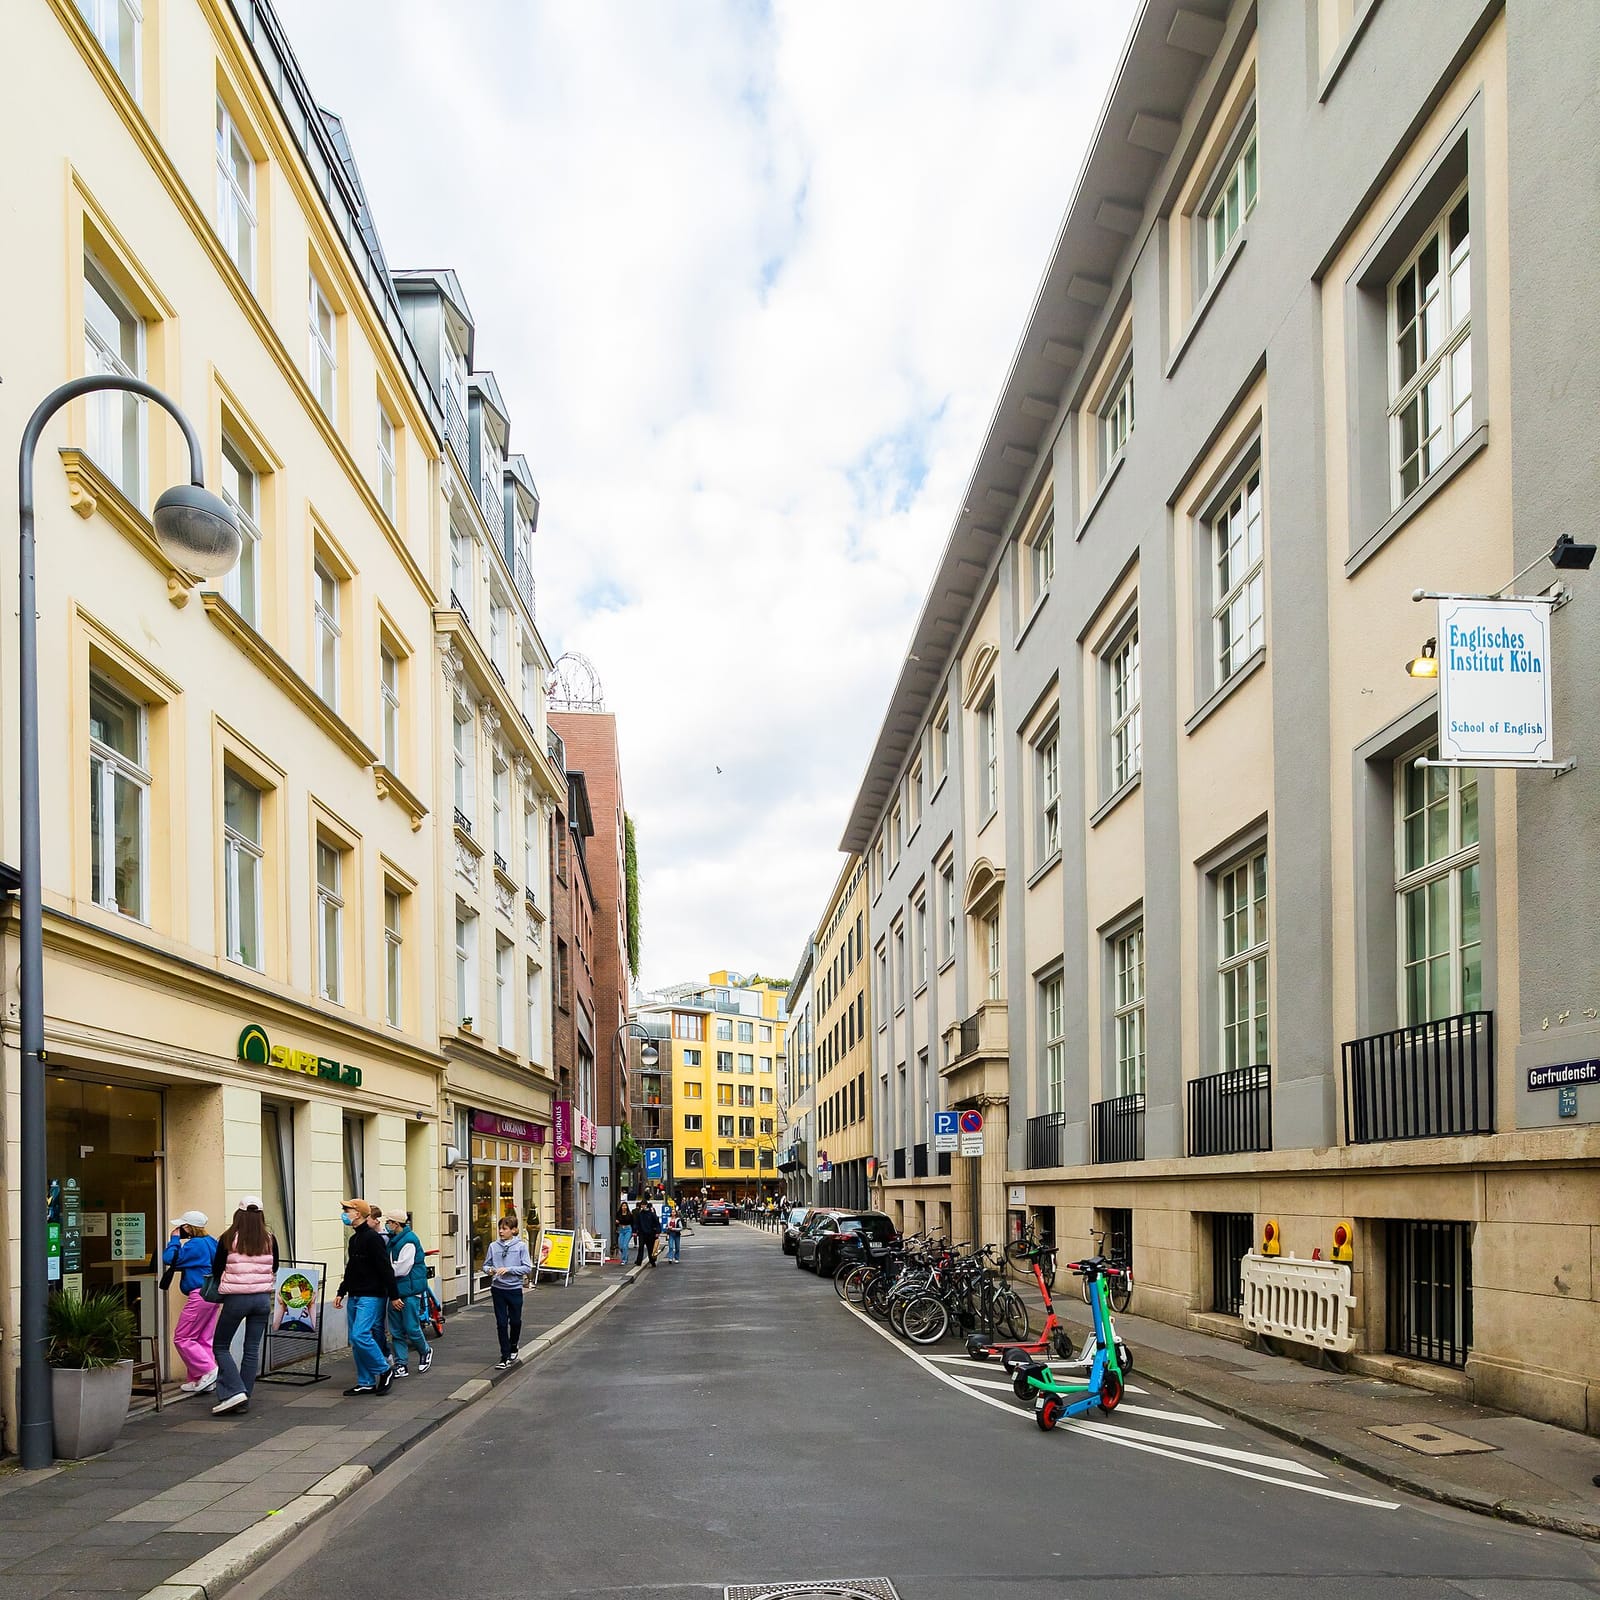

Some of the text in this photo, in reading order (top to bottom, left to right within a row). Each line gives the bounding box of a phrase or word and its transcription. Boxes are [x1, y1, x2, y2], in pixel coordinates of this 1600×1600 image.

[1450, 624, 1525, 652] Englisches
[1450, 649, 1541, 672] Institut Köln
[1451, 721, 1543, 736] School of English
[1530, 1062, 1597, 1085] Gertrudenstr.
[938, 1115, 951, 1133] P
[650, 1151, 657, 1161] P
[600, 1176, 609, 1187] 39
